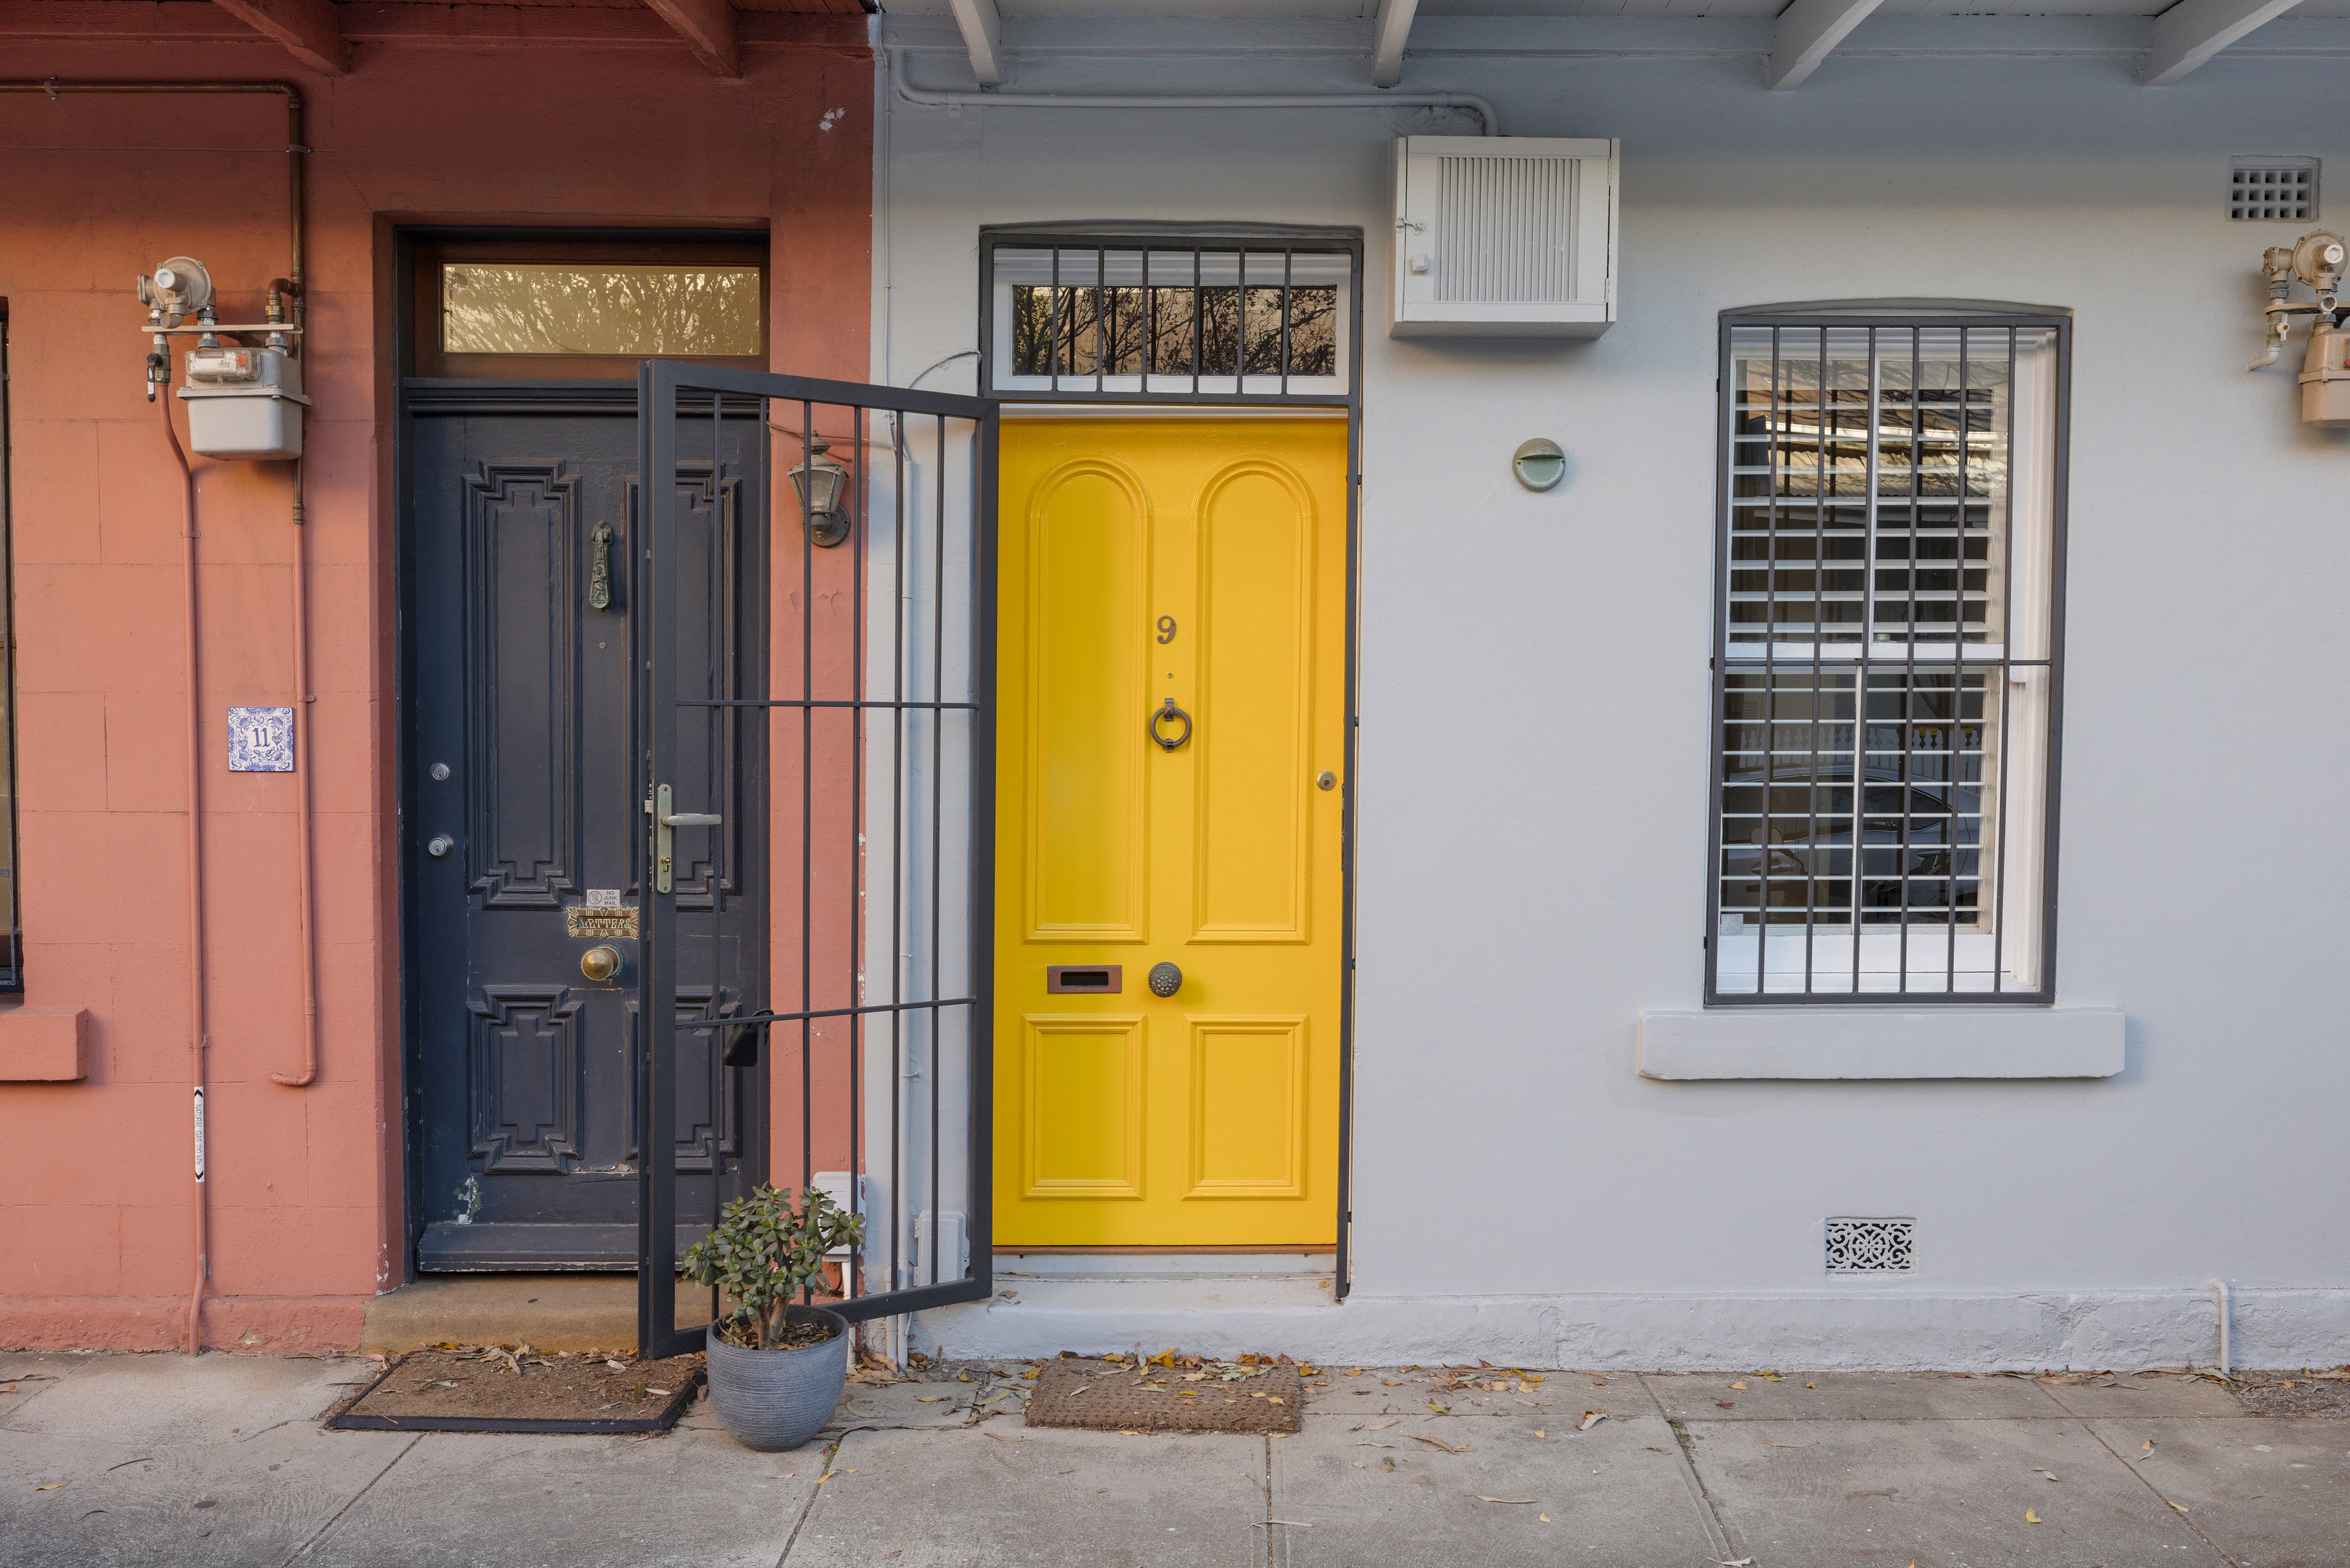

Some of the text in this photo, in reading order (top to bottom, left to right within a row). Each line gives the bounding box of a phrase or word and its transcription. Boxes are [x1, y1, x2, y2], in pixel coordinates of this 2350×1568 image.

[1157, 615, 1176, 644] 9
[252, 727, 270, 748] 11
[580, 918, 632, 929] LETTERS
